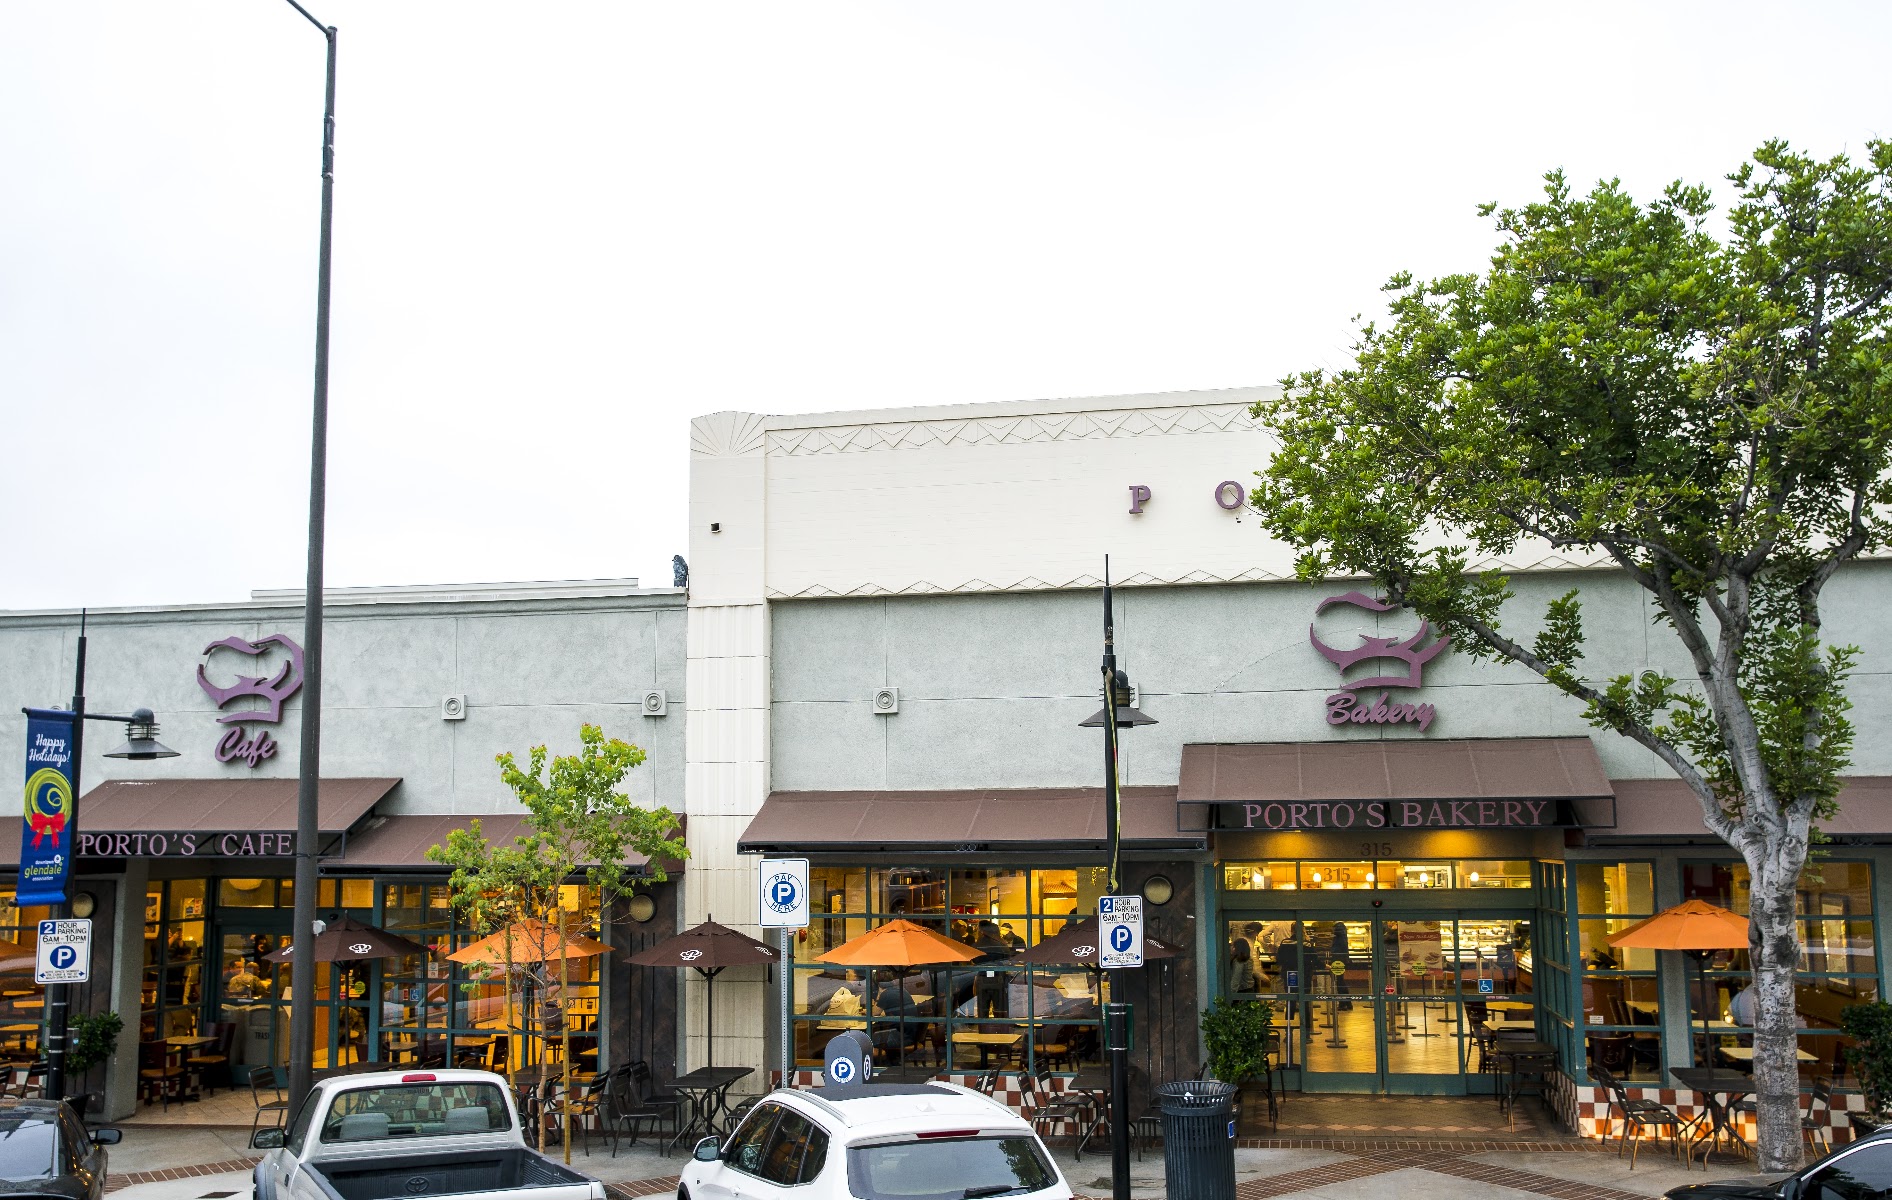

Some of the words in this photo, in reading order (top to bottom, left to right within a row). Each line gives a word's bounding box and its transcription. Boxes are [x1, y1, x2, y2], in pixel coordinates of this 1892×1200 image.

[1325, 691, 1436, 733] Bakery
[35, 733, 67, 753] Happy
[214, 726, 278, 768] Cafe
[28, 748, 71, 768] Holidays!
[1242, 802, 1386, 829] PORTO'S
[1400, 800, 1548, 827] BAKERY
[79, 833, 197, 856] PORTO'S
[221, 833, 293, 856] CAFE
[1360, 842, 1393, 857] 315
[24, 864, 62, 879] glendale
[1323, 867, 1351, 883] 315
[777, 883, 792, 903] P
[1114, 898, 1131, 906] HOUR
[770, 901, 798, 912] HERE
[1103, 898, 1112, 912] 2
[1114, 905, 1140, 913] PARKING
[43, 922, 54, 934] 2
[1116, 928, 1129, 949] P
[57, 947, 72, 967] P
